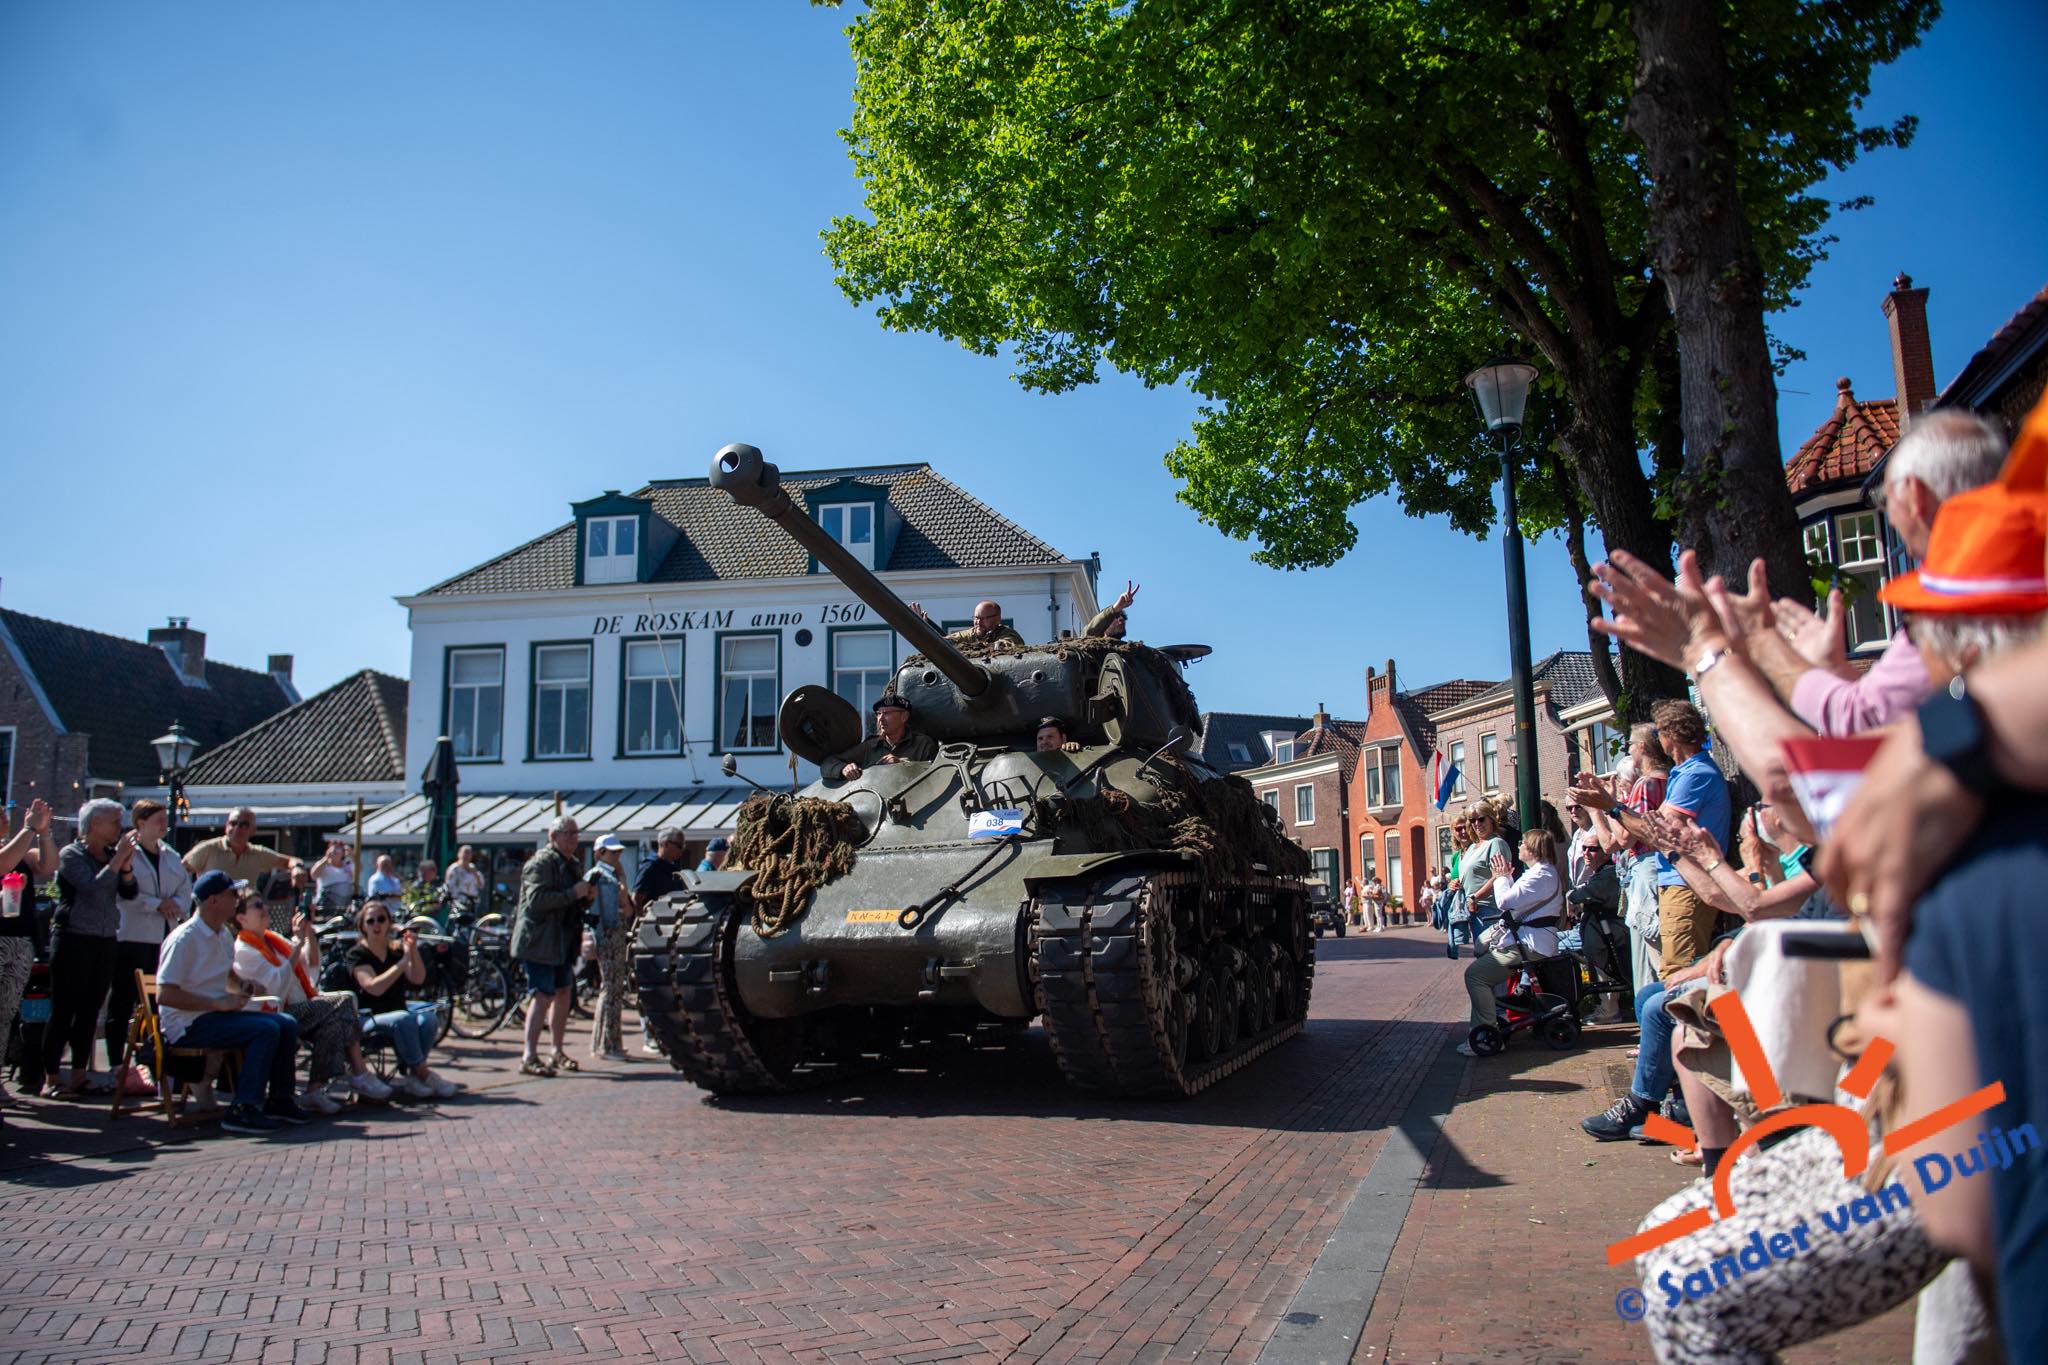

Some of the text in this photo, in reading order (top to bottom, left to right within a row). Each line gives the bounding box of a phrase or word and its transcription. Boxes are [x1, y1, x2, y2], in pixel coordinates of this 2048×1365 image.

[592, 603, 866, 635] DE ROSKAM anno 1560
[987, 818, 1004, 827] 038
